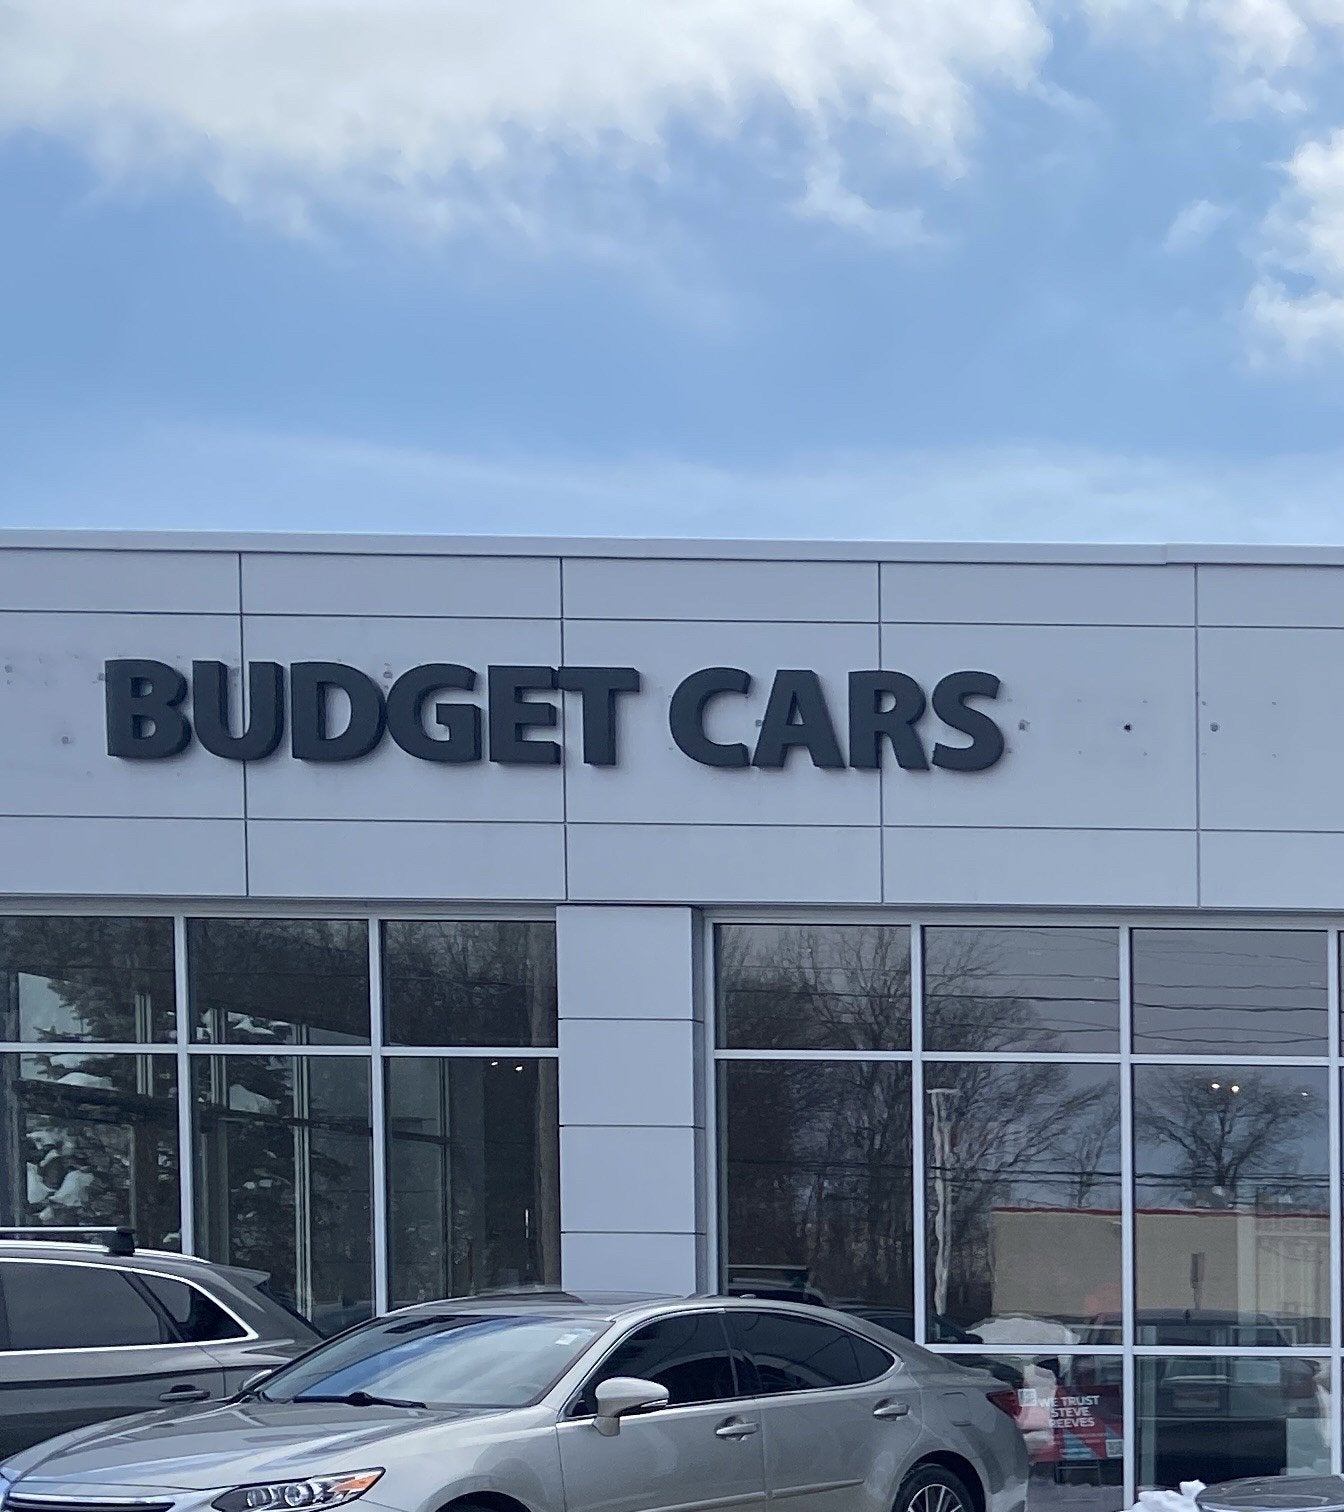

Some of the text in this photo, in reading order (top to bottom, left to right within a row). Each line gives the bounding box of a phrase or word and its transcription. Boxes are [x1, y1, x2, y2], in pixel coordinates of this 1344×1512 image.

[105, 659, 1003, 772] BUDGET CARS
[1060, 1395, 1100, 1407] TRUST
[1050, 1406, 1091, 1418] STEVE
